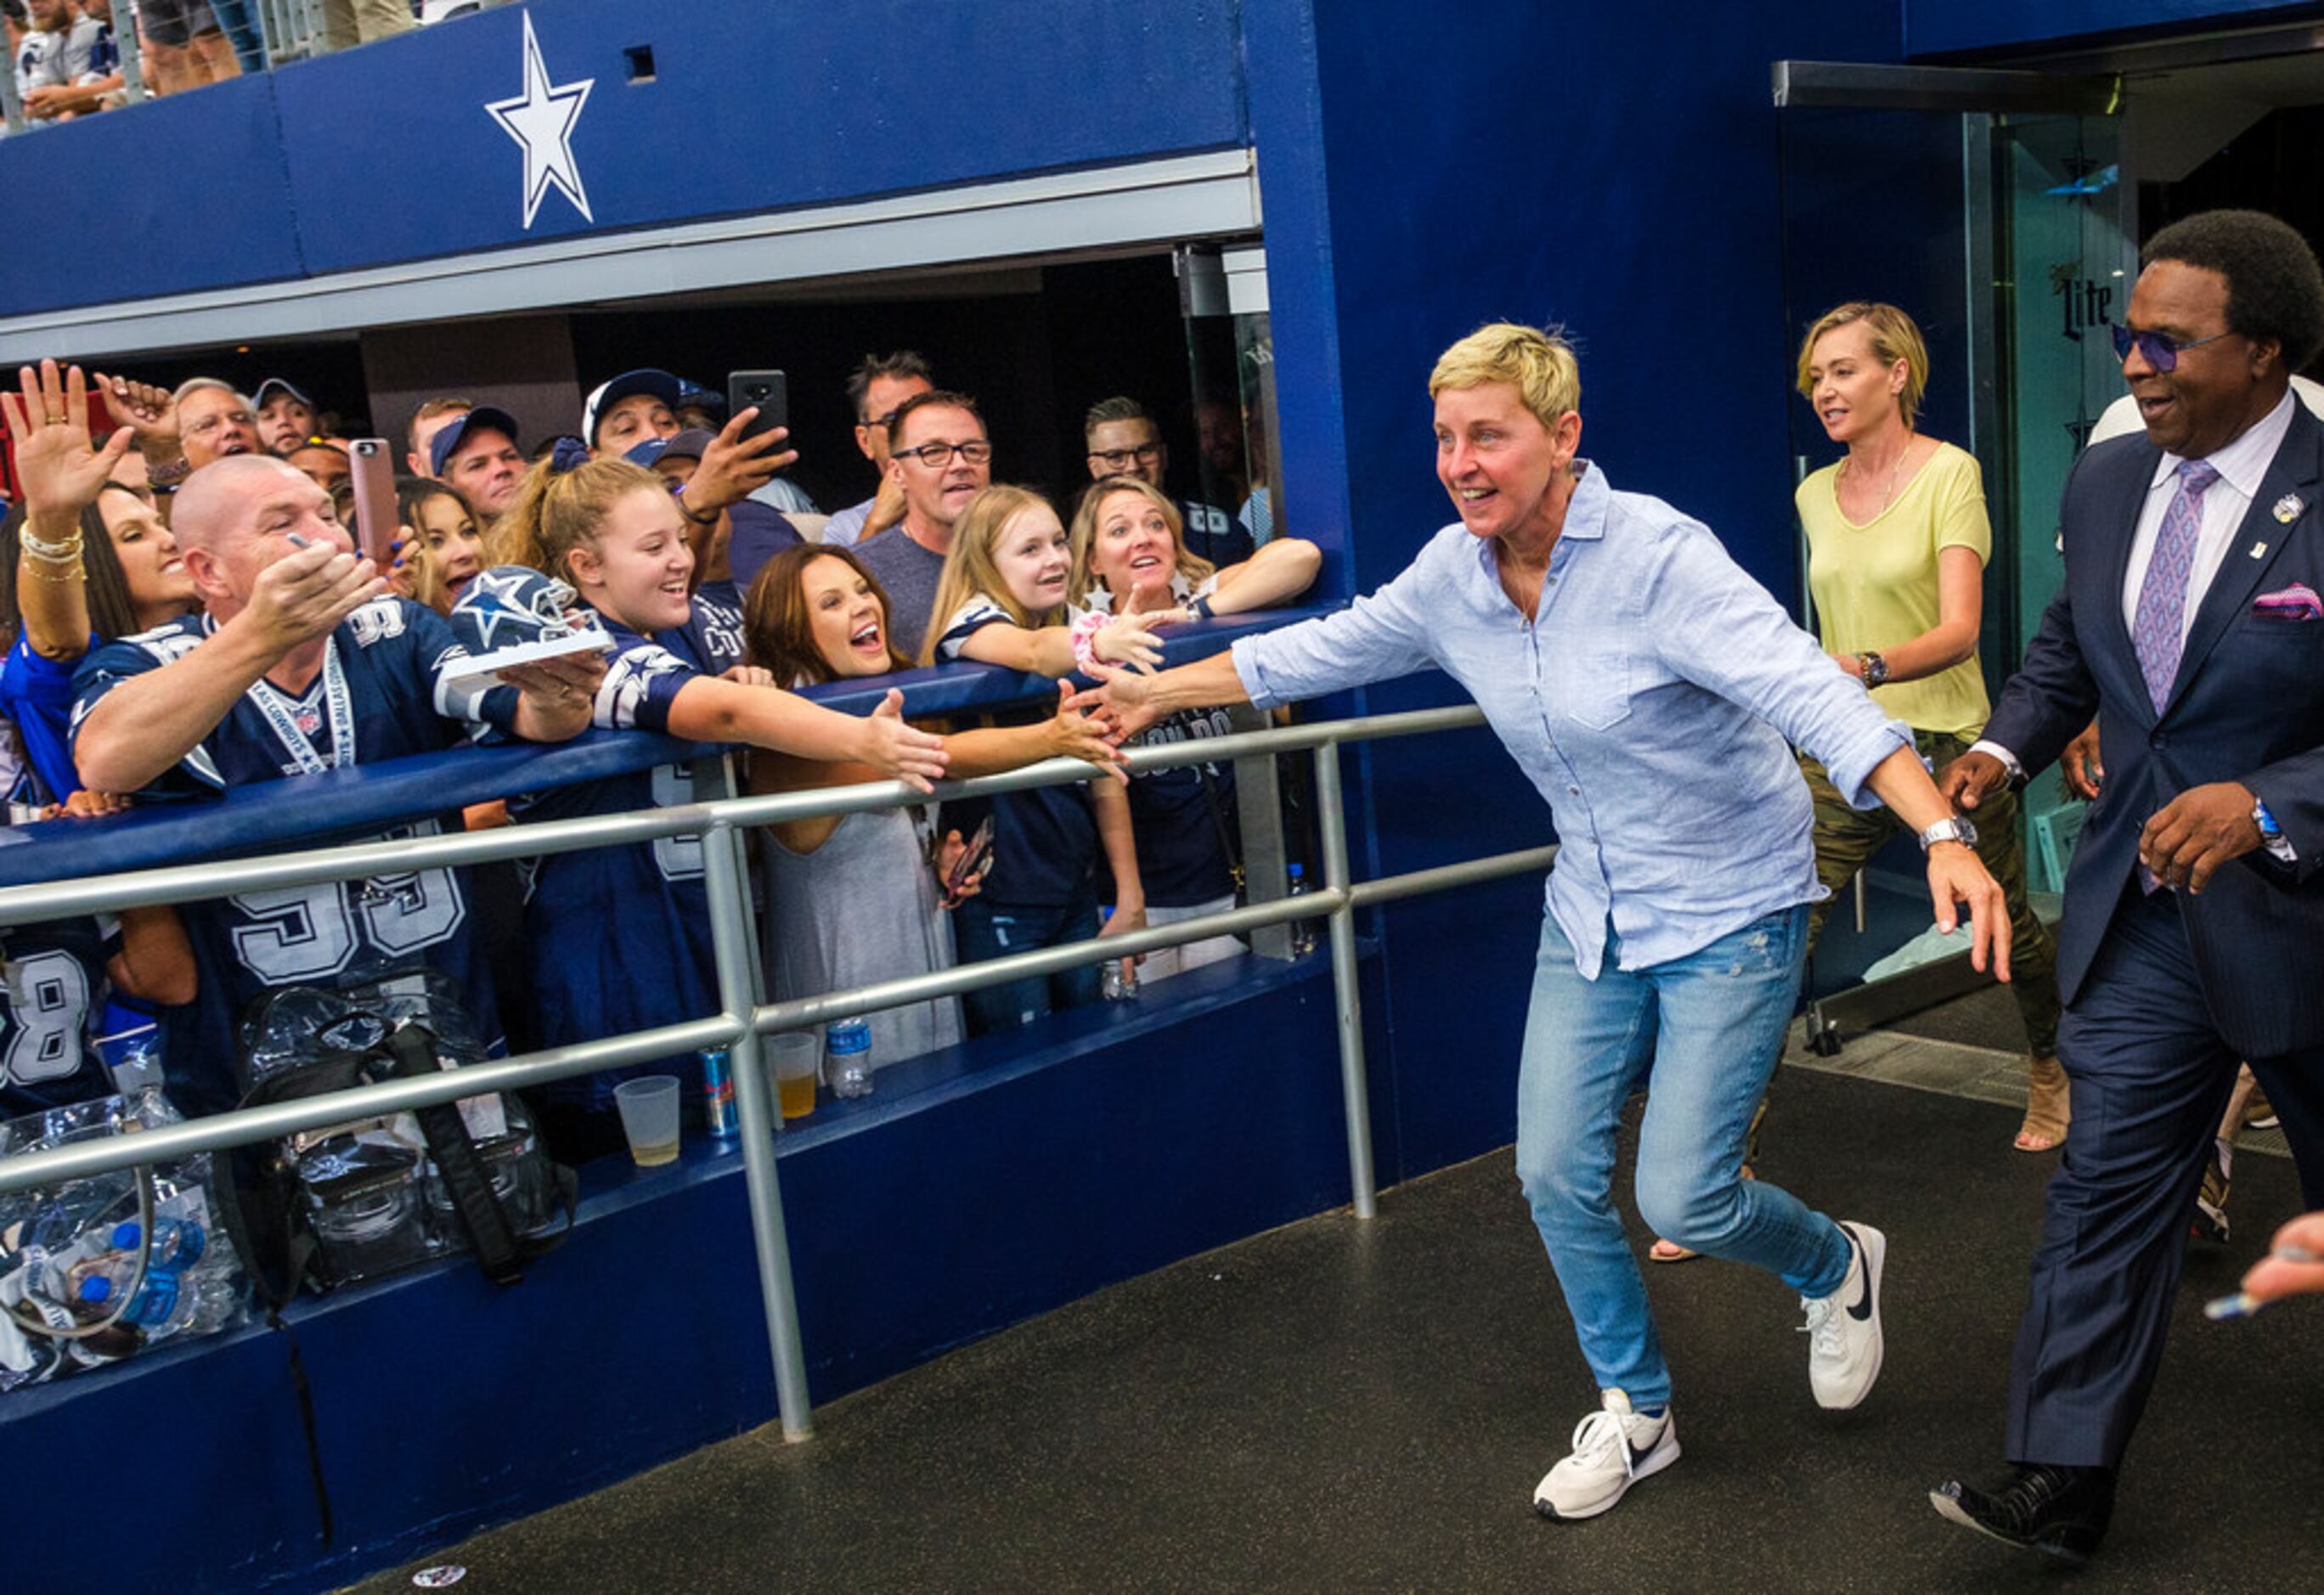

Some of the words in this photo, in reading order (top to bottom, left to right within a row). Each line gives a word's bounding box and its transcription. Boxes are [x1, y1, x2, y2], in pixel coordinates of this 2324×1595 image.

[2062, 279, 2112, 341] Lite
[266, 702, 307, 753] COWBOYS
[0, 949, 89, 1090] 8
